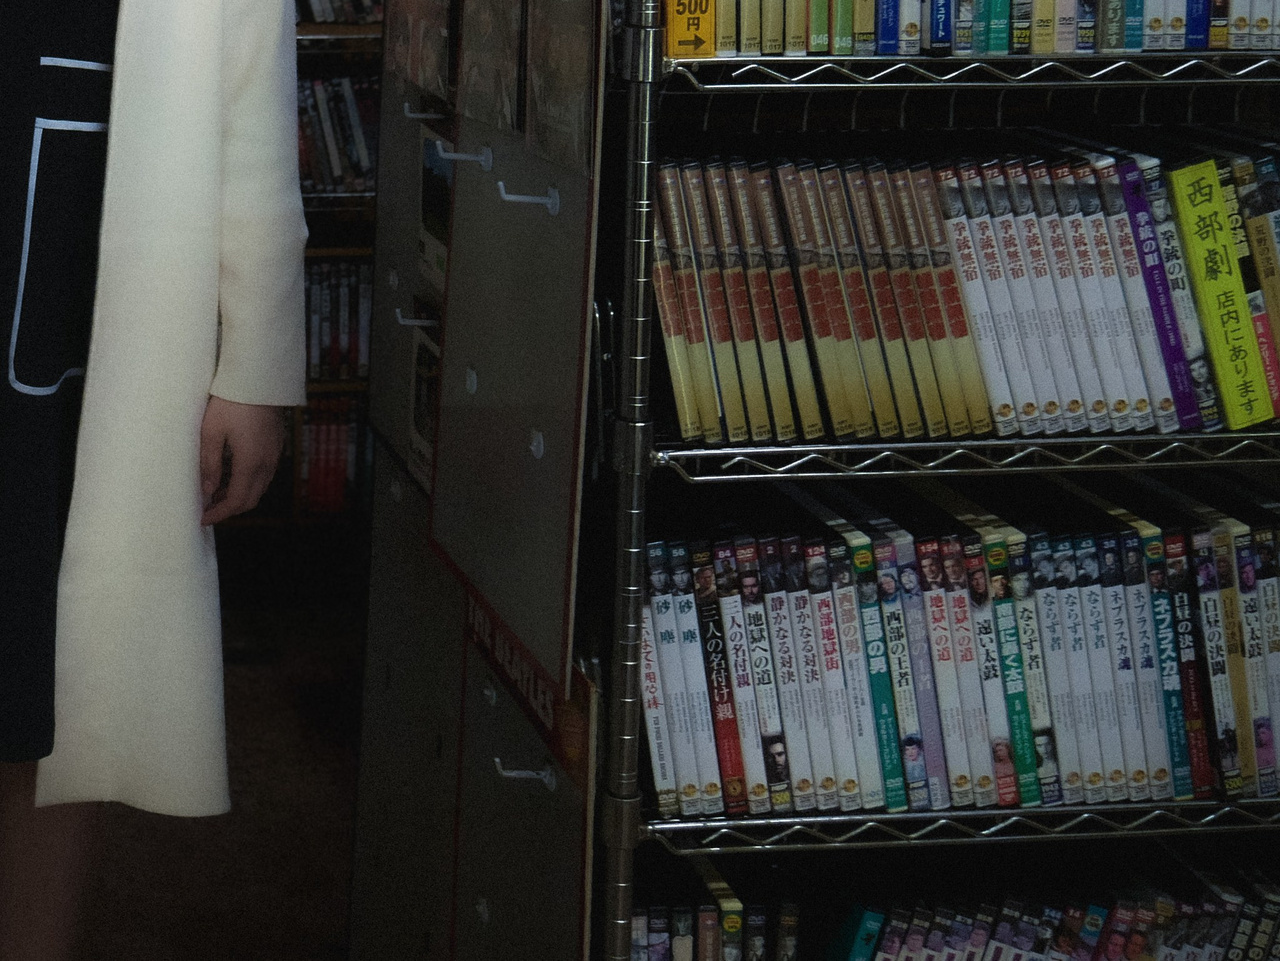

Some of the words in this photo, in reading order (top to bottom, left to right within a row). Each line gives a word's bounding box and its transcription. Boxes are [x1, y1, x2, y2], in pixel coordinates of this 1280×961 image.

[1186, 176, 1233, 282] 西部劇
[1215, 290, 1260, 416] 店内にあります
[655, 599, 676, 645] 砂塵
[677, 599, 699, 644] 砂塵
[723, 598, 752, 689] 三人の名付親
[747, 612, 773, 686] 地獄への道
[770, 596, 797, 686] 静かなる対決
[794, 595, 820, 685] 静かなる対決
[929, 594, 952, 662] 地獄への道
[951, 594, 975, 663] 地獄への道
[1019, 606, 1041, 671] ならず者
[700, 604, 735, 720] 三人の名付け親
